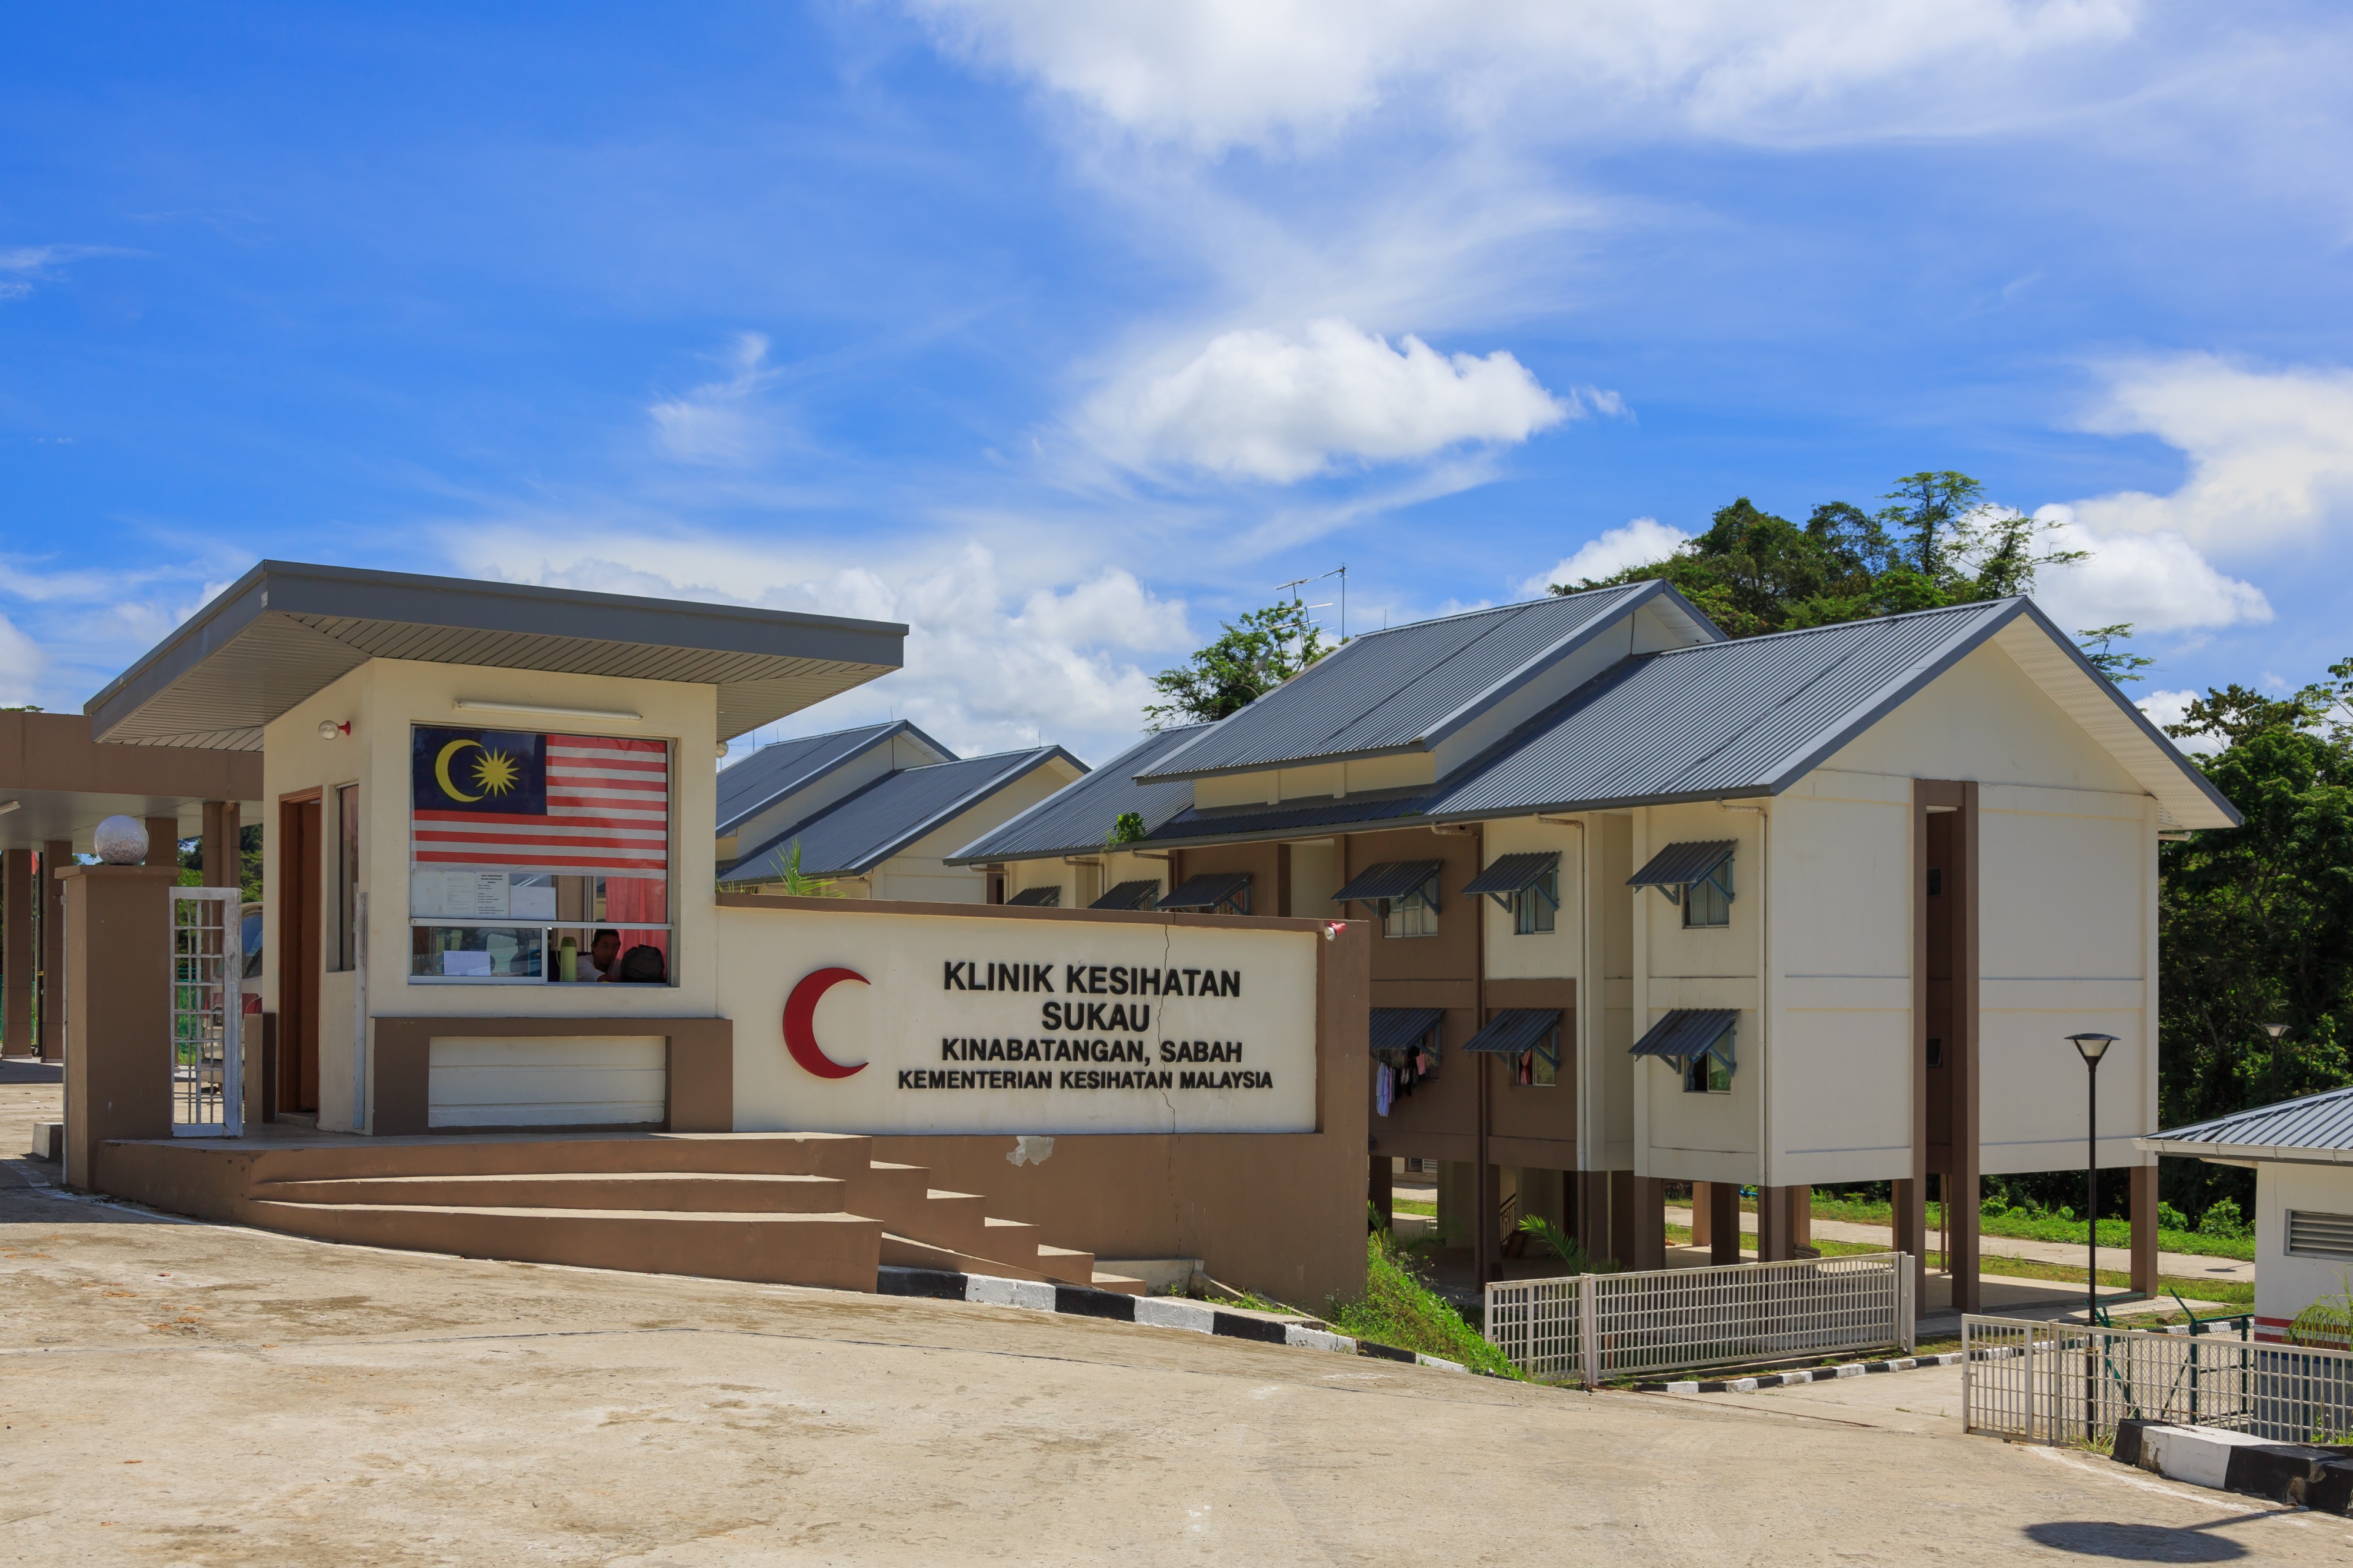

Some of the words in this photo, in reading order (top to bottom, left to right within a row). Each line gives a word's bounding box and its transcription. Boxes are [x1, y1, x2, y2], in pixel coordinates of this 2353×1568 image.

[944, 962, 1055, 993] KLINIK
[1066, 965, 1241, 997] KESIHATAN
[1042, 1002, 1150, 1032] SUKAU
[942, 1039, 1151, 1066] KINABATANGAN,
[1160, 1040, 1242, 1063] SABAH
[898, 1070, 1052, 1089] KEMENTERIAN
[1060, 1071, 1173, 1090] KESIHATAN
[1179, 1072, 1274, 1089] MALAYSIA
